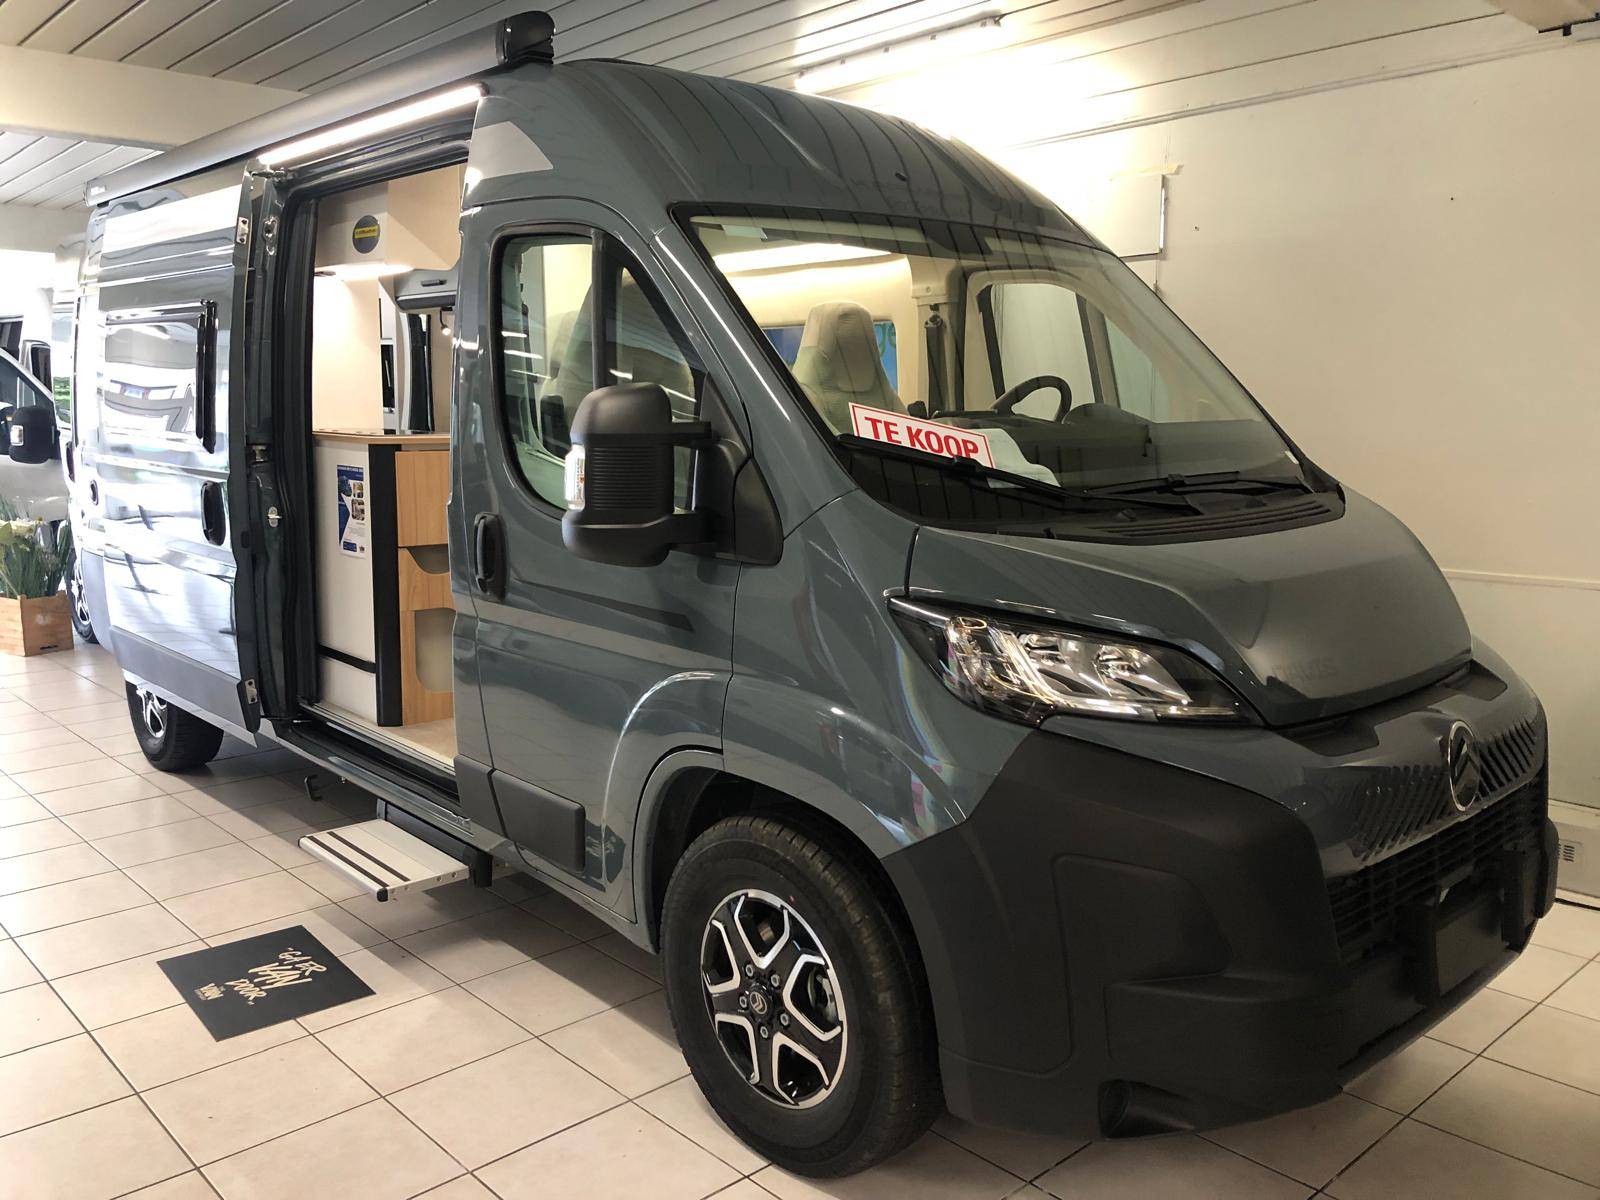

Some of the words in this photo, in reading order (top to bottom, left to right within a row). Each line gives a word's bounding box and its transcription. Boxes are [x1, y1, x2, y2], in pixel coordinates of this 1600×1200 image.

[864, 416, 902, 445] TE
[906, 425, 979, 459] KOOP
[248, 962, 313, 990] VAN
